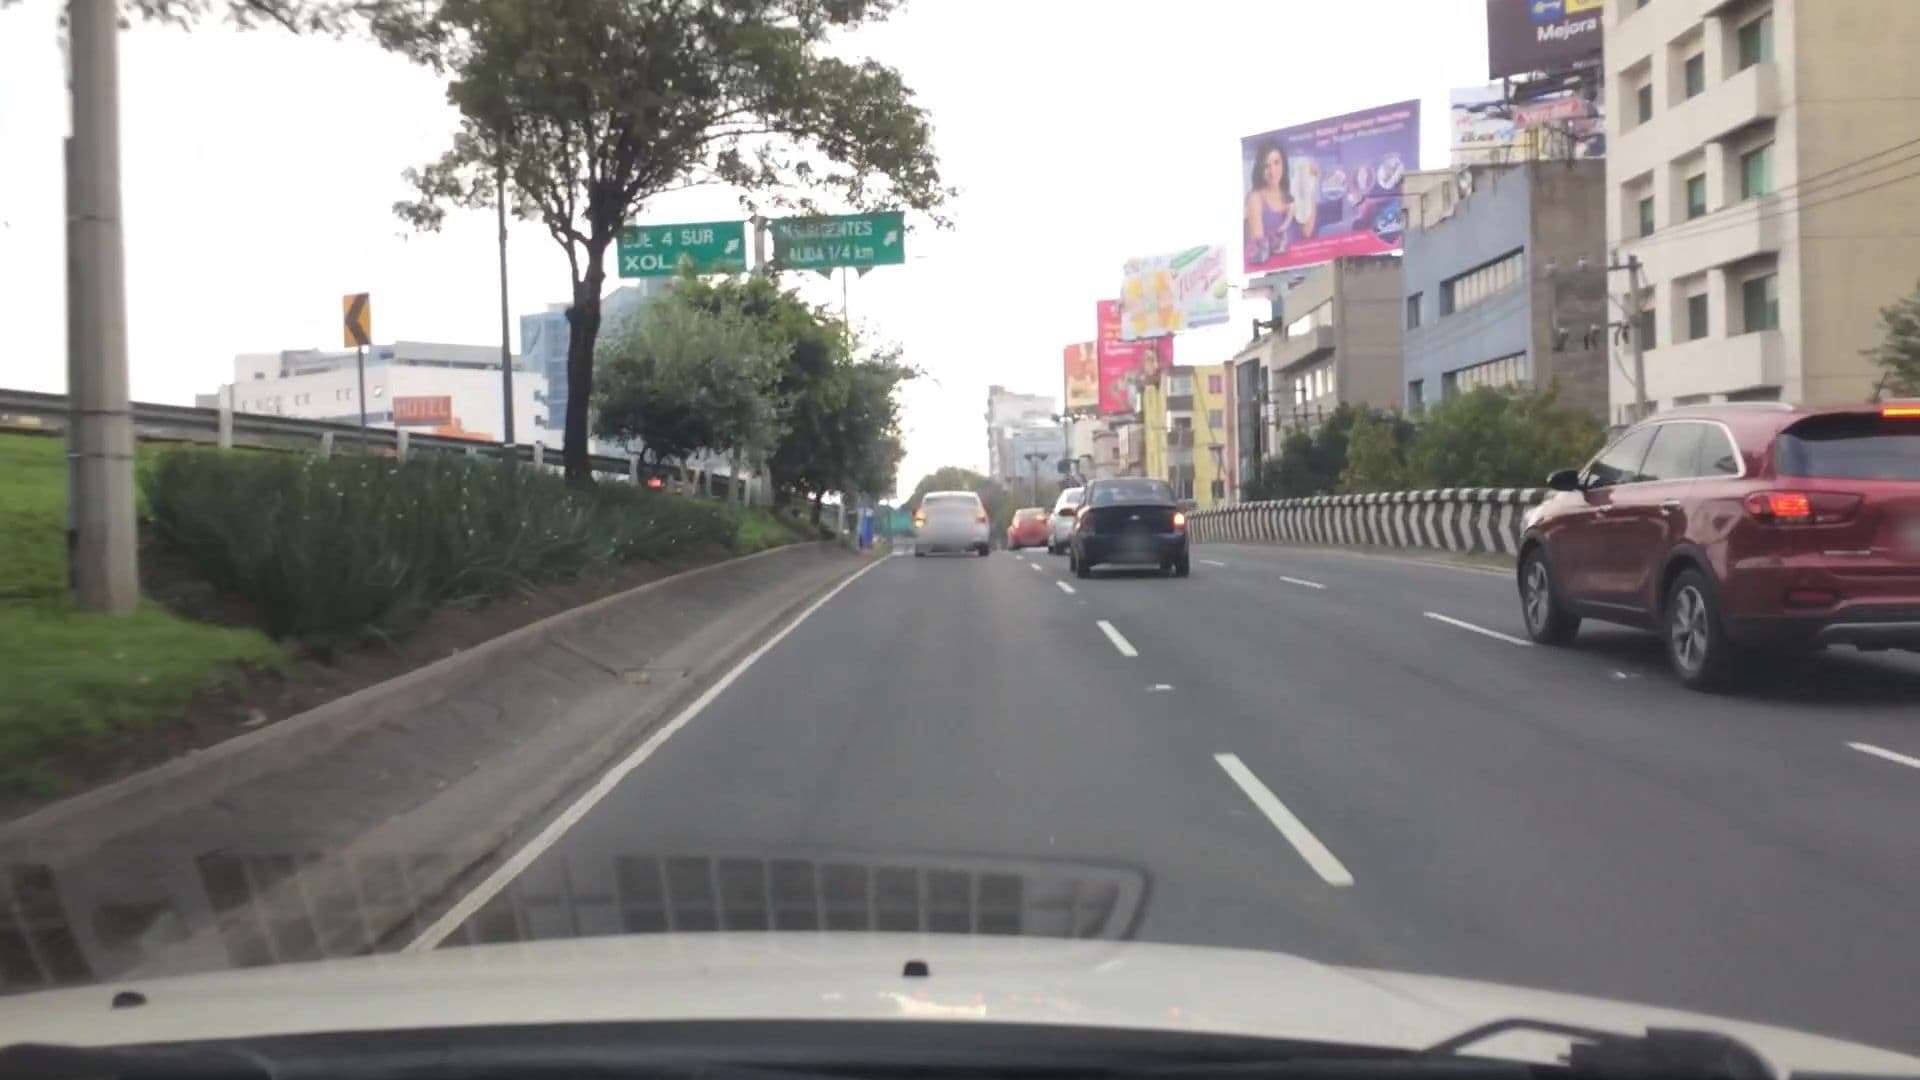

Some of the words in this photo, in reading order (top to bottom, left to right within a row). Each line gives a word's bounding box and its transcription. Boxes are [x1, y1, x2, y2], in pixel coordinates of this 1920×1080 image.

[1537, 17, 1597, 41] Mejora
[661, 231, 673, 247] 4
[681, 229, 714, 246] SUR
[783, 246, 825, 262] ALIDA
[395, 398, 449, 418] HOTEL
